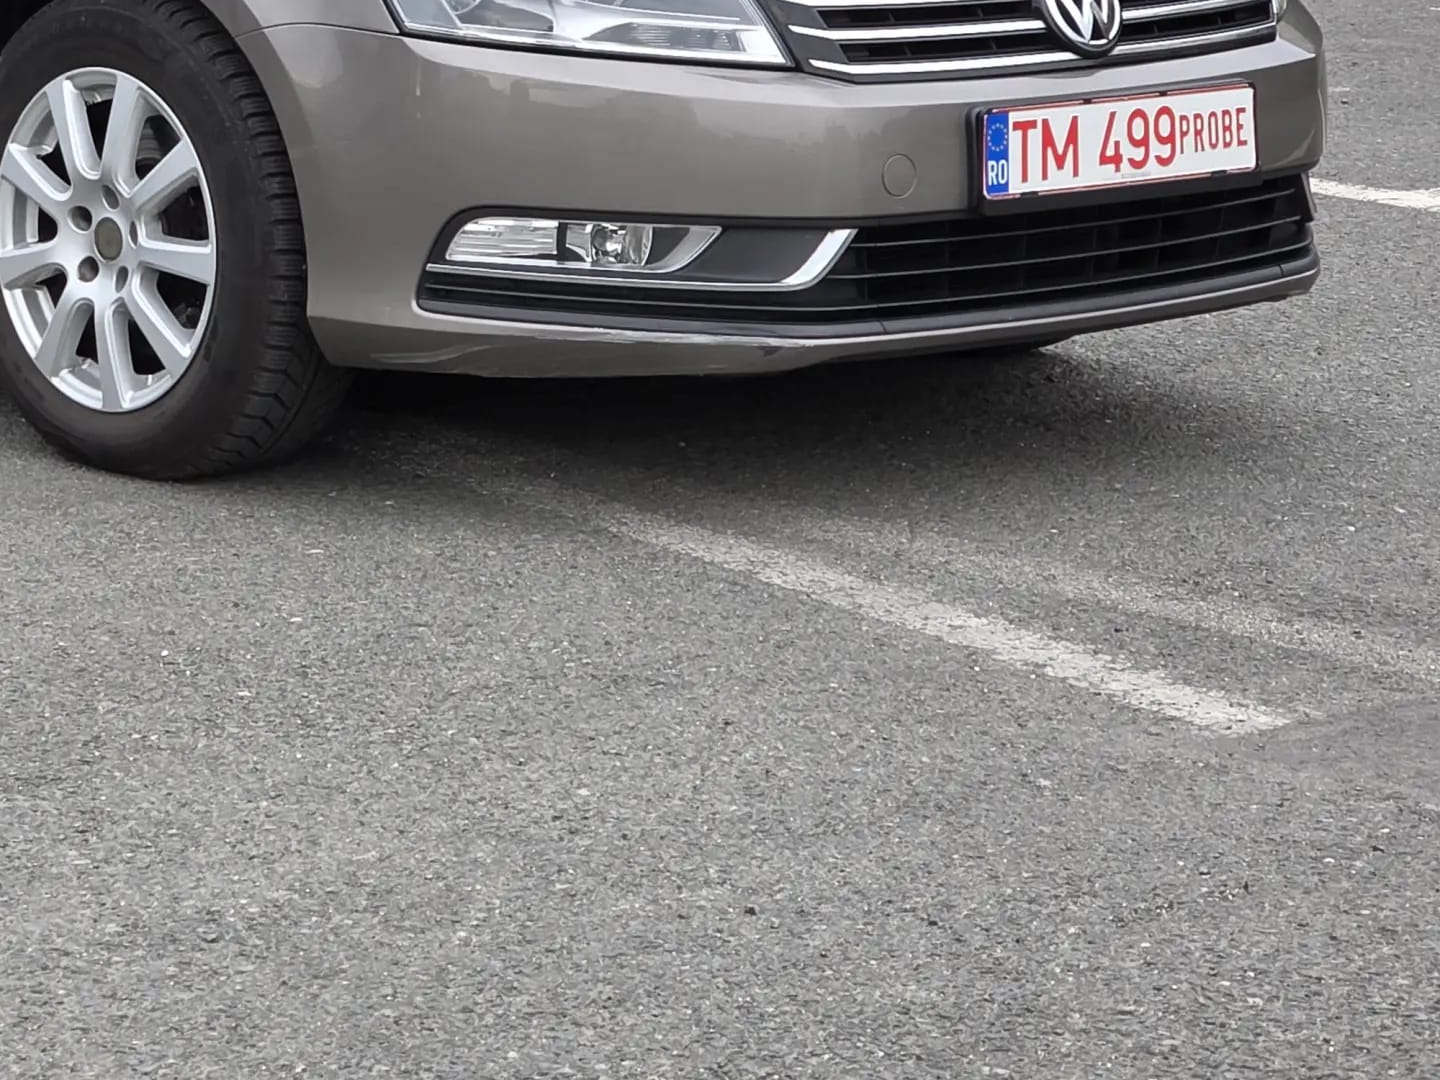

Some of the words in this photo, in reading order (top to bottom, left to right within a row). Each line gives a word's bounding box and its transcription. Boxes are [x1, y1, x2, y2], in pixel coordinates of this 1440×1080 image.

[987, 159, 1008, 186] RO
[1012, 115, 1079, 183] TM
[1098, 105, 1177, 173] 499
[1179, 107, 1248, 155] PROBE
